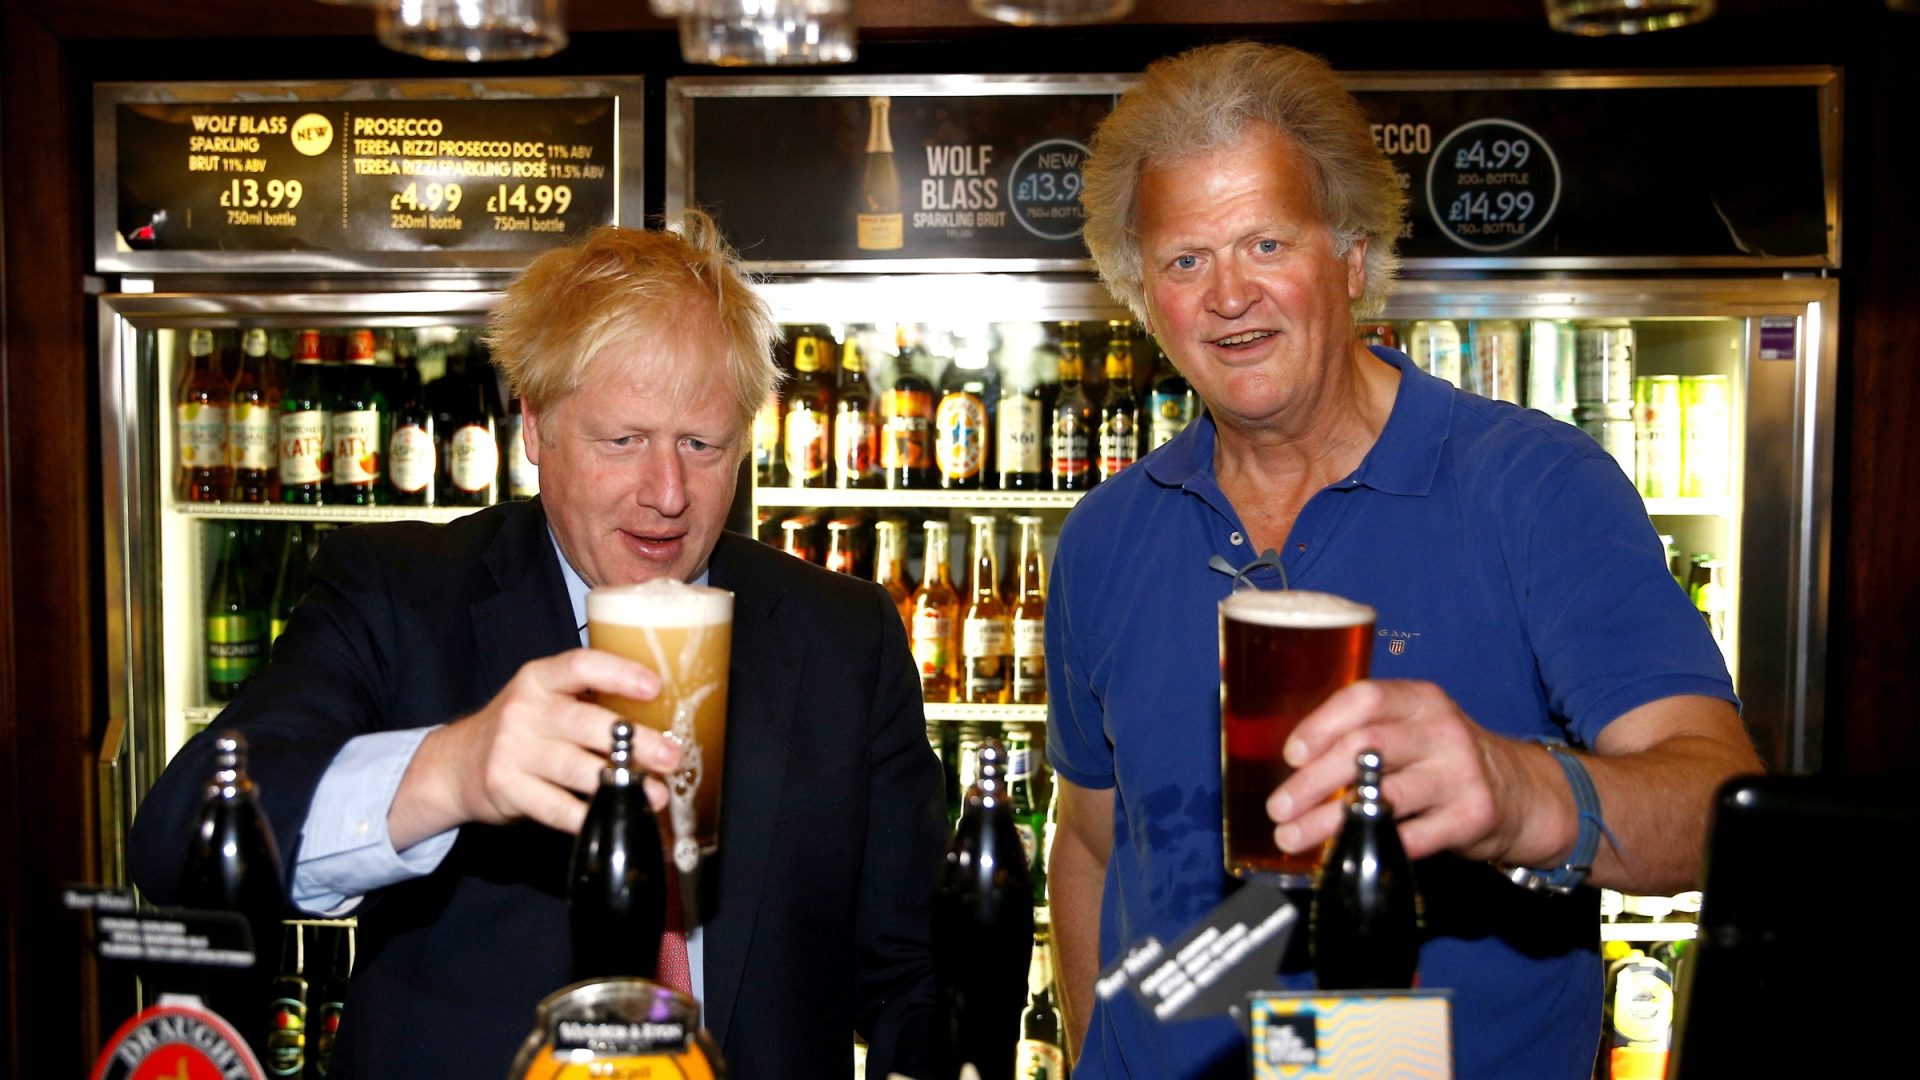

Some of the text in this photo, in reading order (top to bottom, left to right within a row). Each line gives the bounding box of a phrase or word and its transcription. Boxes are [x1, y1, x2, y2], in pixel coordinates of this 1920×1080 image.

[192, 115, 287, 135] WOLF BLASS
[297, 126, 328, 141] NEW
[354, 118, 443, 137] PROSECCO
[189, 137, 260, 153] SPARKLING
[354, 139, 593, 160] TERESA RIZZI PROSECCO DOC 11% ABV
[1454, 139, 1530, 169] £4.99
[189, 156, 267, 173] BRUT 11% ABV
[353, 158, 605, 179] TERESA RIZZI SPARKLING ROSÉ 11.5% ABV
[926, 145, 993, 177] WOLF
[1038, 153, 1079, 169] NEW
[1485, 172, 1529, 185] BOTTLE
[220, 179, 303, 209] £13.99
[391, 182, 572, 214] £4.99 £14.99
[921, 179, 998, 210] BLASS
[1051, 207, 1087, 218] BOTTL
[1448, 191, 1535, 221] £14.99
[227, 211, 297, 226] 750ml bottle
[391, 214, 565, 233] 250ml bottle 750ml bottle
[913, 211, 975, 229] SPARKLING
[977, 211, 1006, 228] BRUT
[1483, 222, 1526, 234] BOTTLE
[283, 437, 325, 457] KATY
[337, 436, 368, 457] ATY
[1378, 629, 1421, 639] GANT
